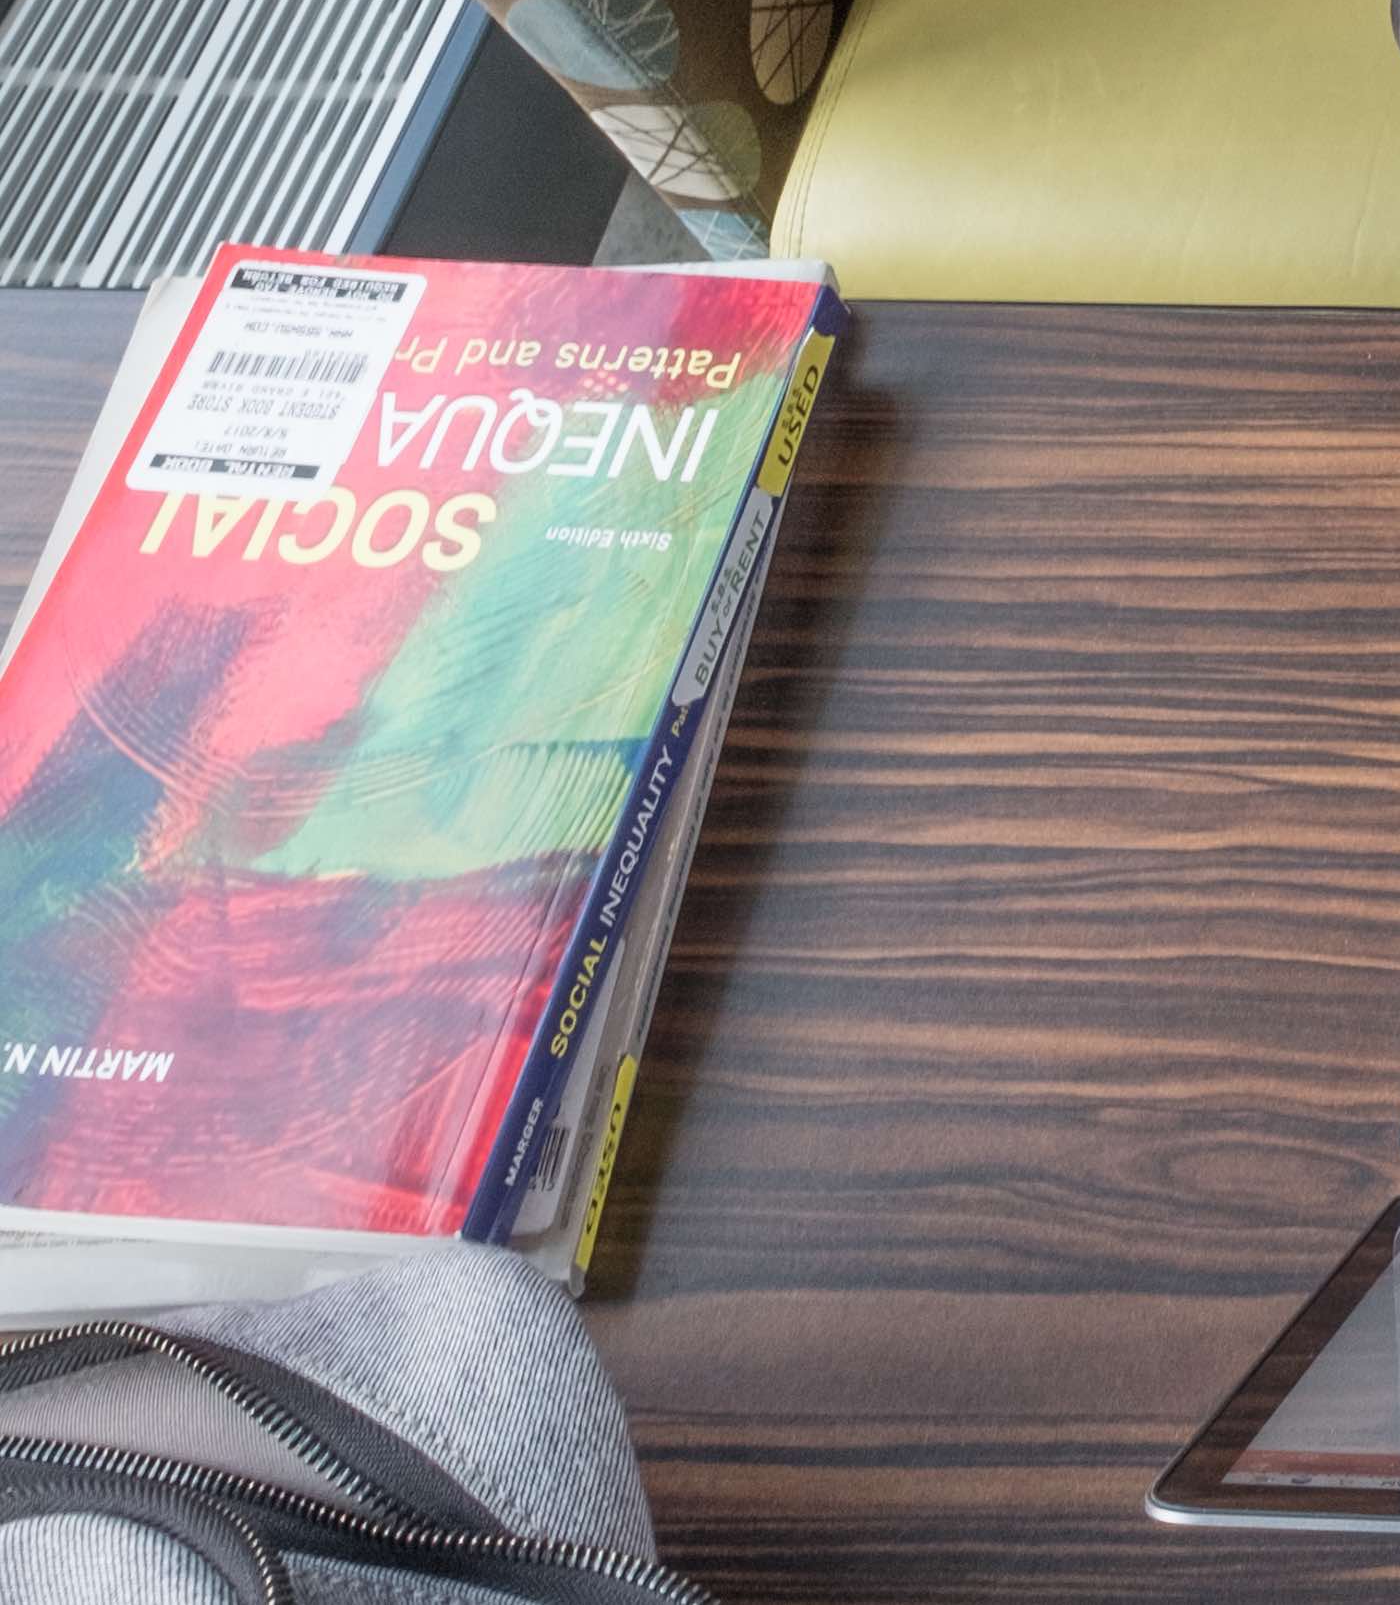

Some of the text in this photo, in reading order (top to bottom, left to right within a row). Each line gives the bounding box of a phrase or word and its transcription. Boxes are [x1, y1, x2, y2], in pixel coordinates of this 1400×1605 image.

[455, 339, 540, 377] and
[554, 343, 740, 389] Patterns
[187, 393, 341, 420] STUDENT BOOK STORE
[778, 363, 820, 468] USED
[375, 390, 720, 482] INEQUA
[162, 457, 294, 480] RENTAL BOOK
[546, 523, 673, 552] Sixth Edition
[694, 622, 726, 687] BUY
[730, 509, 767, 587] RENT
[550, 935, 610, 1060] SOCIAL
[599, 743, 675, 930] INEQUALITY
[3, 1041, 176, 1084] MARTIN N.
[503, 1097, 546, 1189] MARGER
